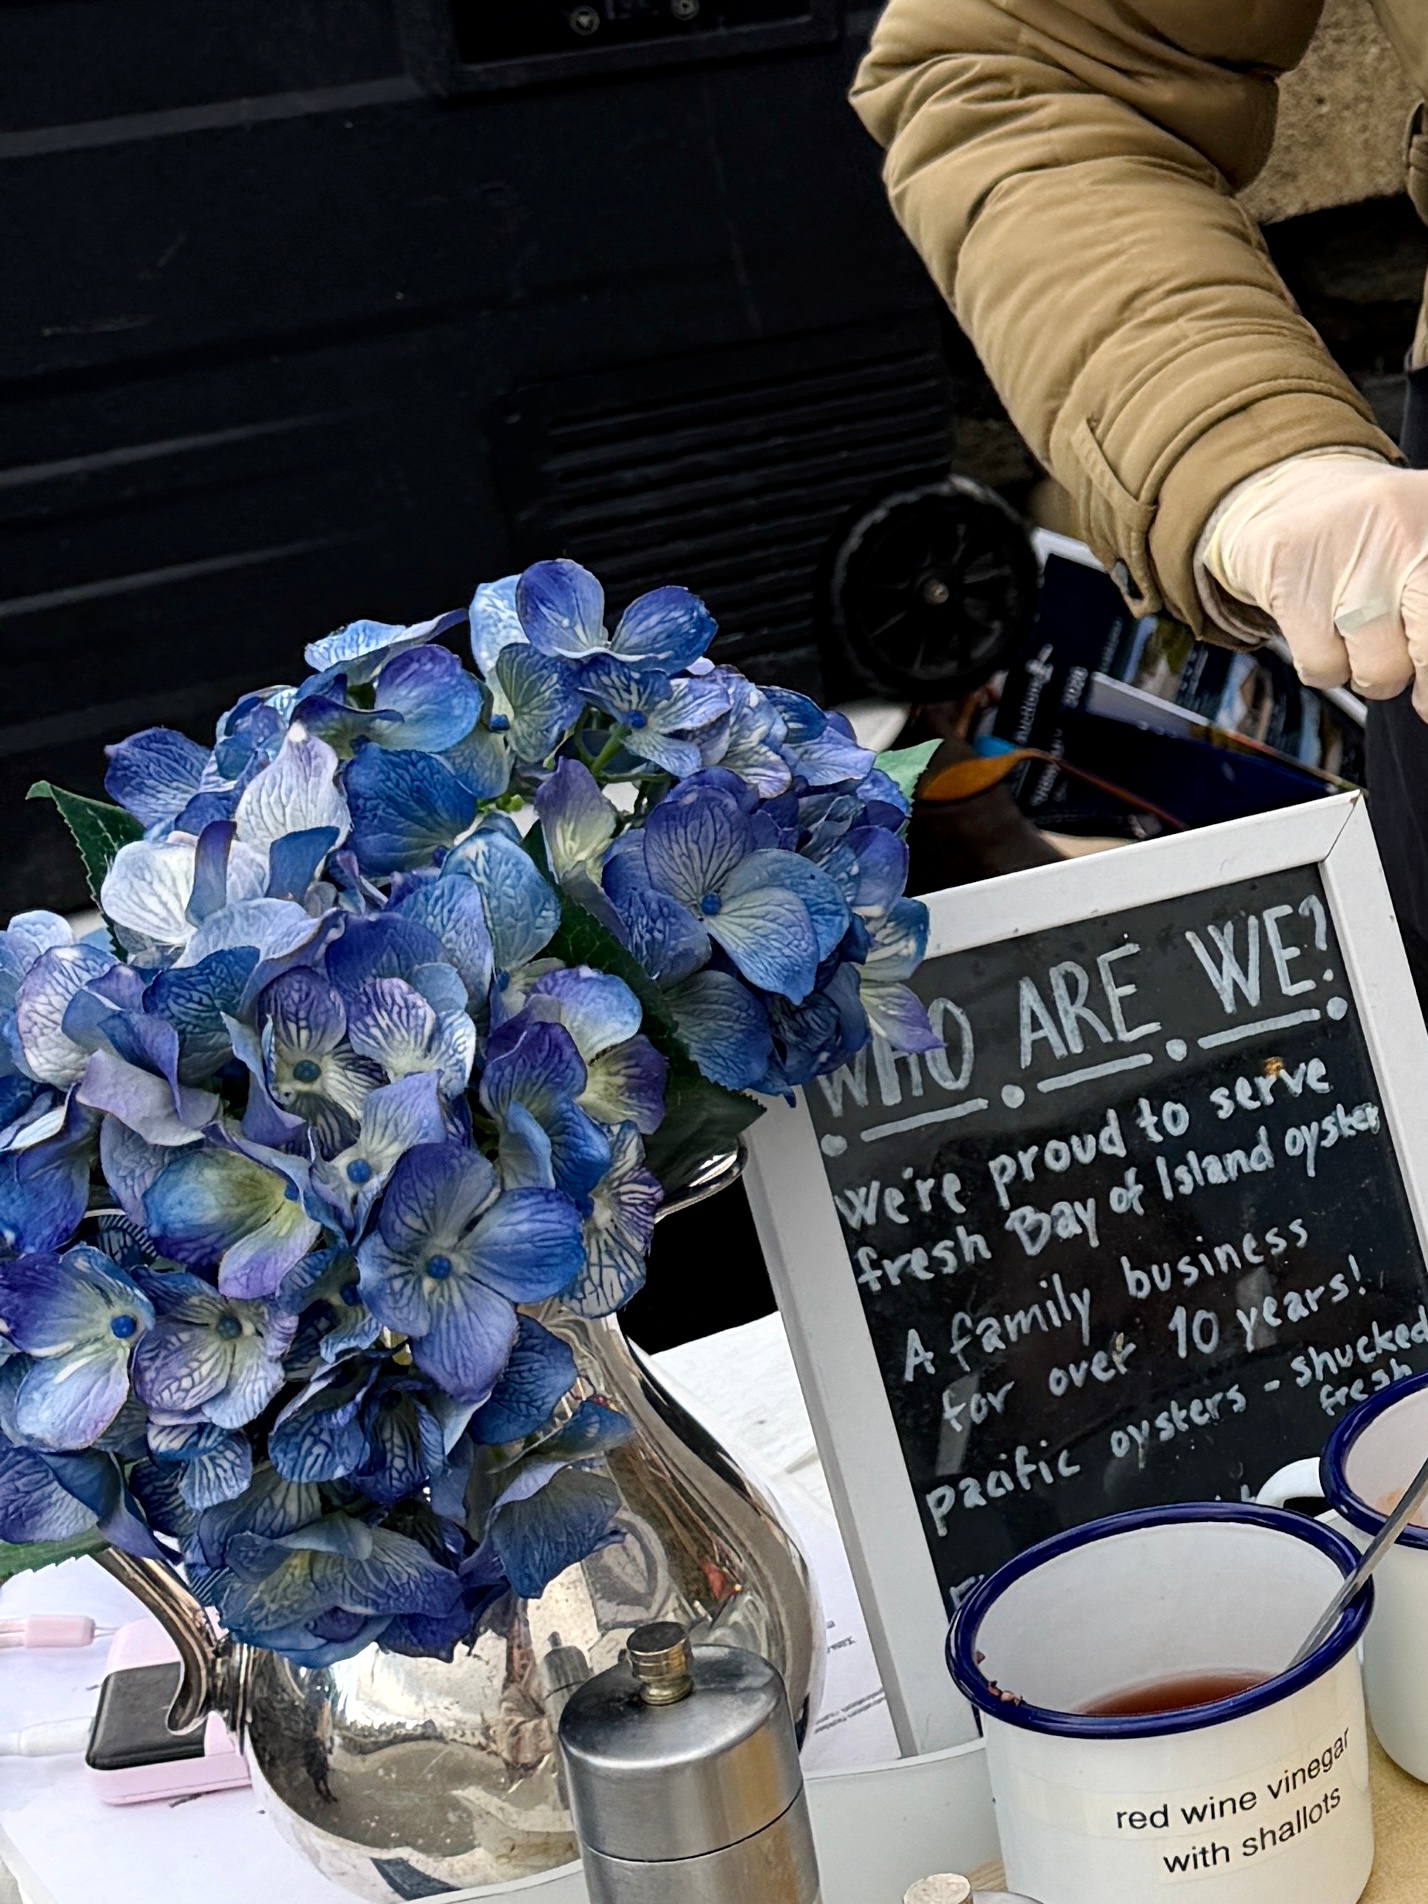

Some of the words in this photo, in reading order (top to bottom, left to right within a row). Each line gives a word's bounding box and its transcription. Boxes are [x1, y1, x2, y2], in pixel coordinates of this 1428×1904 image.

[1018, 943, 1162, 1069] ARE
[1186, 896, 1337, 1015] WE?
[990, 1108, 1125, 1205] proud
[1136, 1098, 1190, 1146] to
[1209, 1057, 1331, 1120] serve
[856, 1230, 993, 1293] fresh
[1005, 1193, 1100, 1255] Bay
[1110, 1173, 1146, 1216] of
[1158, 1130, 1275, 1201] Island
[903, 1336, 937, 1383] A
[950, 1272, 1093, 1375] family
[1120, 1216, 1310, 1299] business
[942, 1377, 1013, 1434] for
[1049, 1333, 1137, 1395] over
[1169, 1303, 1220, 1358] 10
[1237, 1255, 1371, 1353] years!
[925, 1443, 1081, 1537] pacific
[1109, 1383, 1248, 1469] oysters
[1319, 1358, 1413, 1416] fresh
[1117, 1803, 1169, 1829] red
[1180, 1791, 1257, 1825] wine
[1267, 1727, 1349, 1799] vinegar
[1163, 1842, 1230, 1873] with
[1242, 1787, 1341, 1857] shallots
